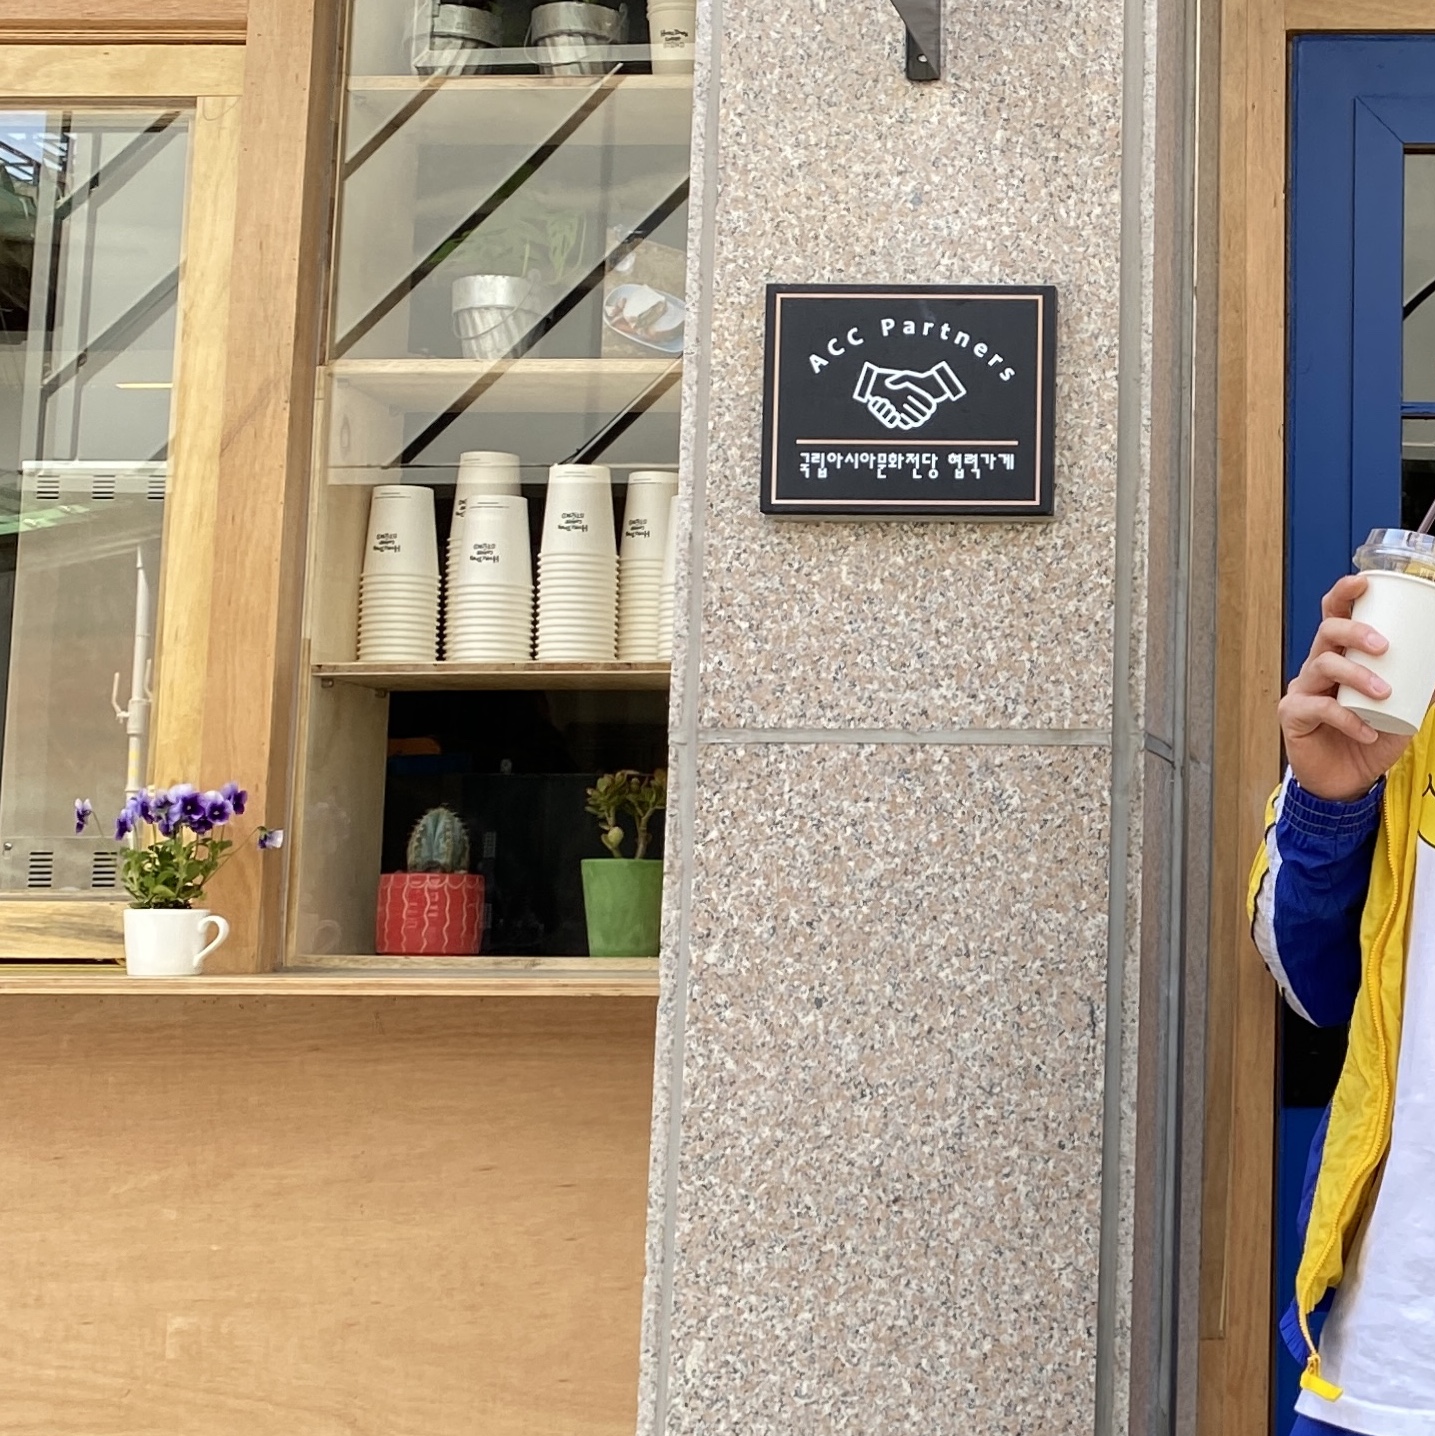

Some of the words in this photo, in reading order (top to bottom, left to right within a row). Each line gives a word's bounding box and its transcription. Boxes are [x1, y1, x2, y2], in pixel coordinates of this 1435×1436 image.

[881, 318, 1016, 382] Partners
[799, 452, 939, 480] 국립아시아문화전당
[947, 452, 1015, 480] 협력가게
